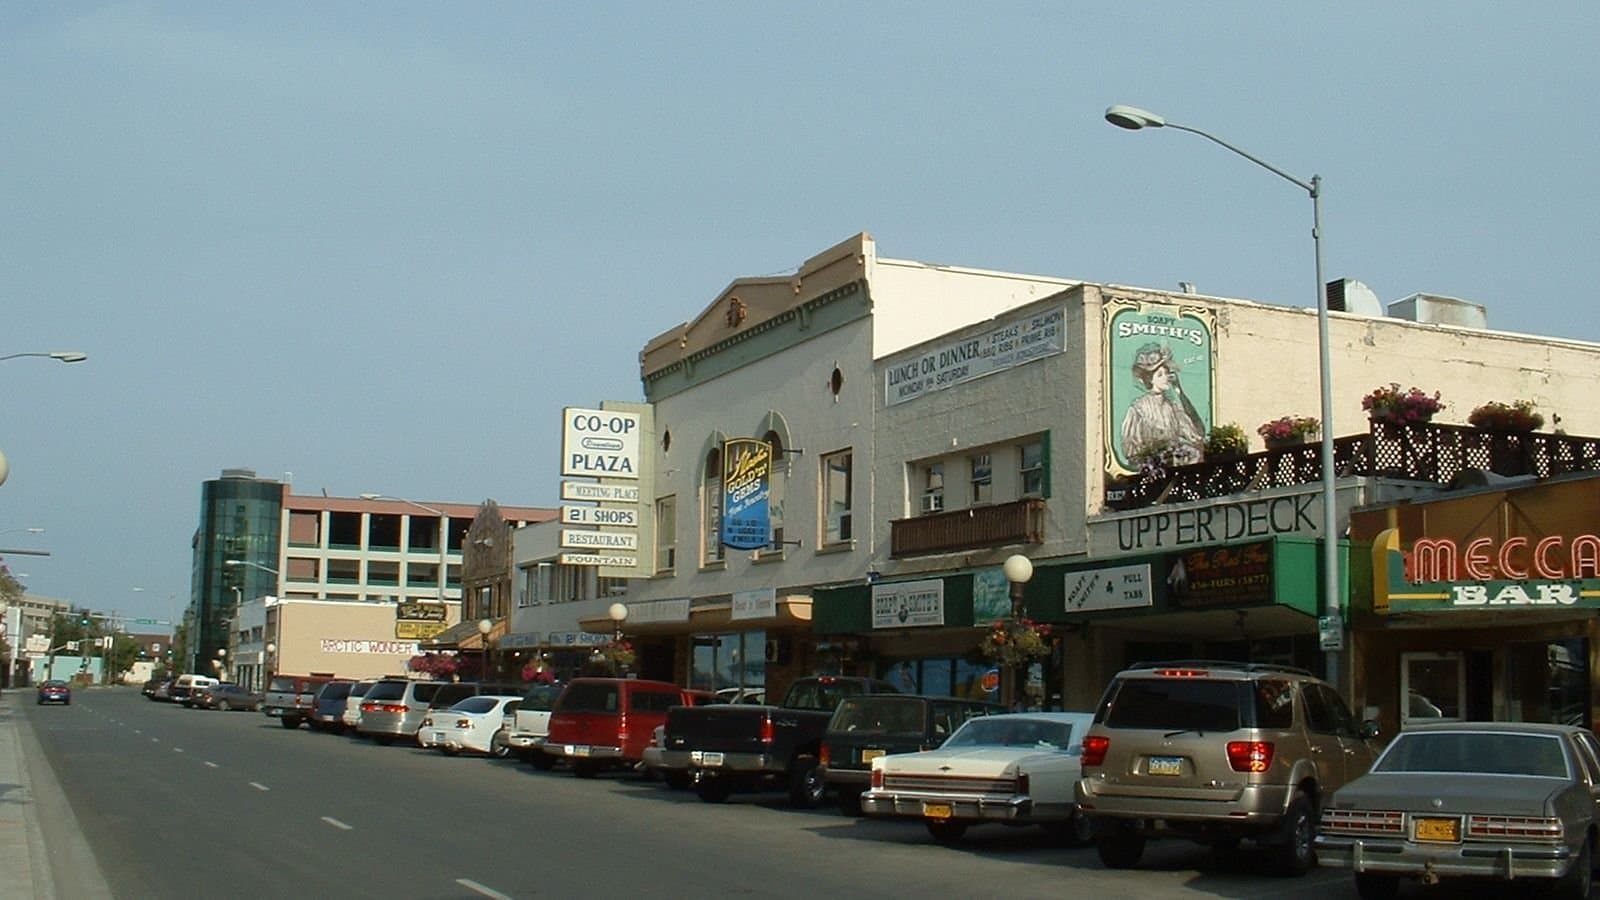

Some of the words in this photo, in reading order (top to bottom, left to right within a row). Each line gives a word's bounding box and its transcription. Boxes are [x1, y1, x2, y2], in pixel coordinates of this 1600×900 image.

[1119, 322, 1202, 346] SMITH'S
[888, 360, 919, 386] LUNCH
[921, 356, 937, 376] OR
[939, 340, 980, 369] DINNER
[574, 415, 635, 434] CO-OP
[572, 454, 633, 473] PLAZA
[727, 470, 756, 493] GOLD
[570, 509, 586, 521] 21
[594, 510, 633, 523] SHOPS
[1117, 506, 1216, 551] UPPER
[1225, 494, 1317, 541] DECK
[569, 534, 633, 547] RESTAURANT
[567, 556, 633, 565] FOUNTAIN
[1413, 534, 1600, 583] MECCA
[1123, 573, 1143, 584] PULL
[1124, 590, 1144, 600] TABS
[1452, 584, 1578, 606] BAR
[320, 640, 362, 653] ARCTIC
[368, 641, 413, 654] WONDER
